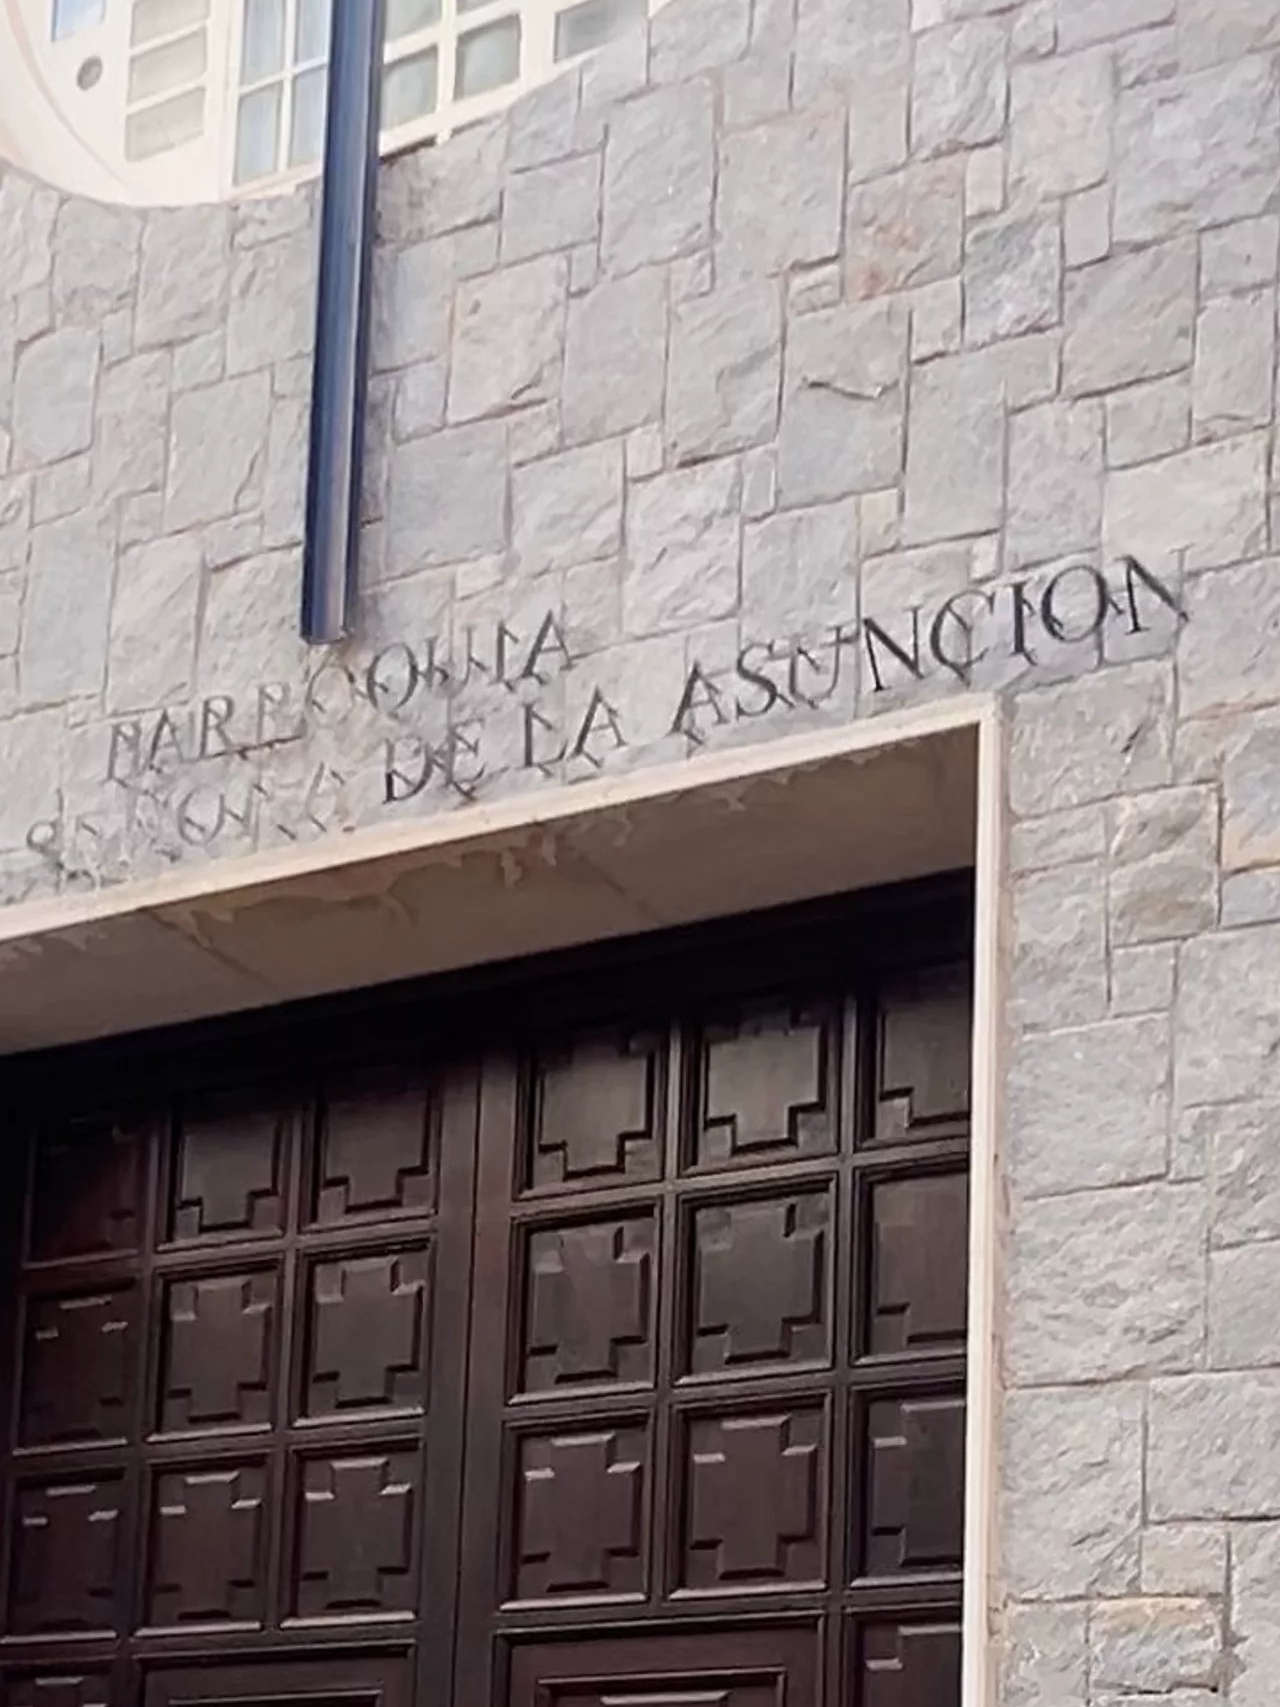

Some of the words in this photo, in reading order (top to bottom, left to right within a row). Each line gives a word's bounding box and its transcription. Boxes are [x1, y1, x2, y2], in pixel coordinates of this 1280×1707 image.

[382, 717, 486, 805] DE
[521, 685, 626, 770] LA
[667, 545, 1192, 739] ASUNCION
